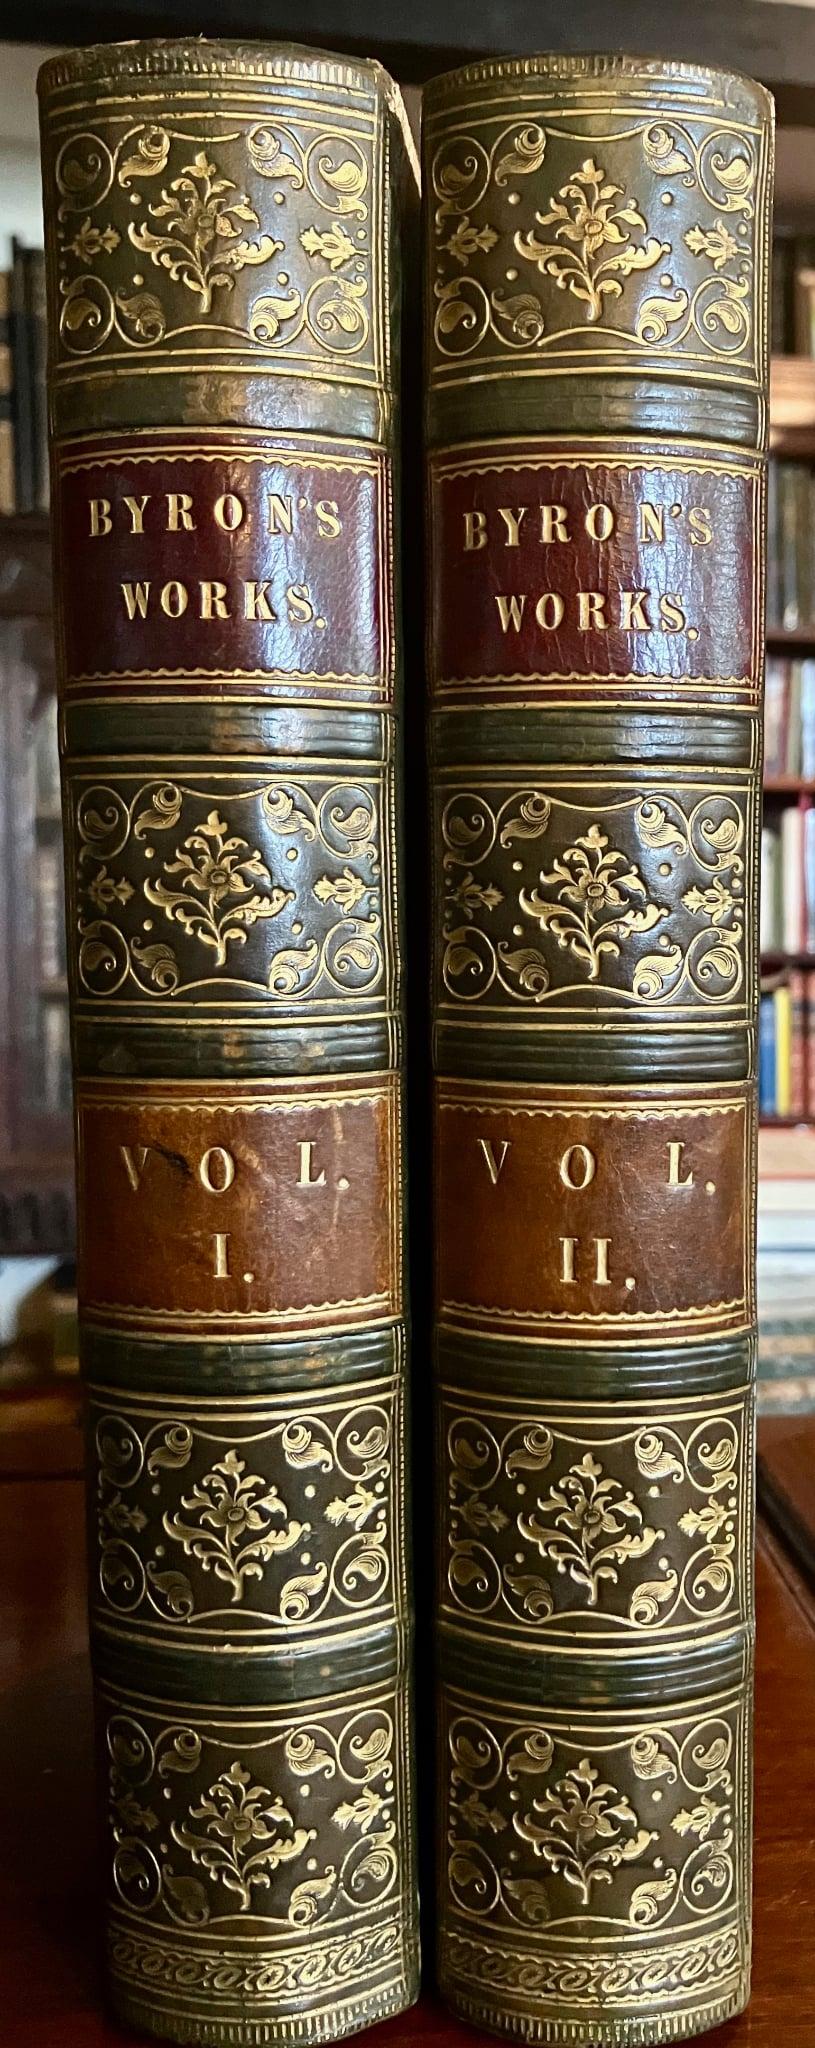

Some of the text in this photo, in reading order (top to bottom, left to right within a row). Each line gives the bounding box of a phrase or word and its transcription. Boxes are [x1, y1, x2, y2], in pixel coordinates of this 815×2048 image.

[88, 493, 342, 538] BYRON'S
[463, 502, 713, 551] BYRON'S
[121, 580, 328, 630] WORKS.
[494, 591, 700, 641] WORKS.
[121, 1141, 350, 1193] VOL.
[477, 1138, 716, 1196] VOL.
[211, 1232, 255, 1283] I.
[559, 1237, 636, 1291] II.
